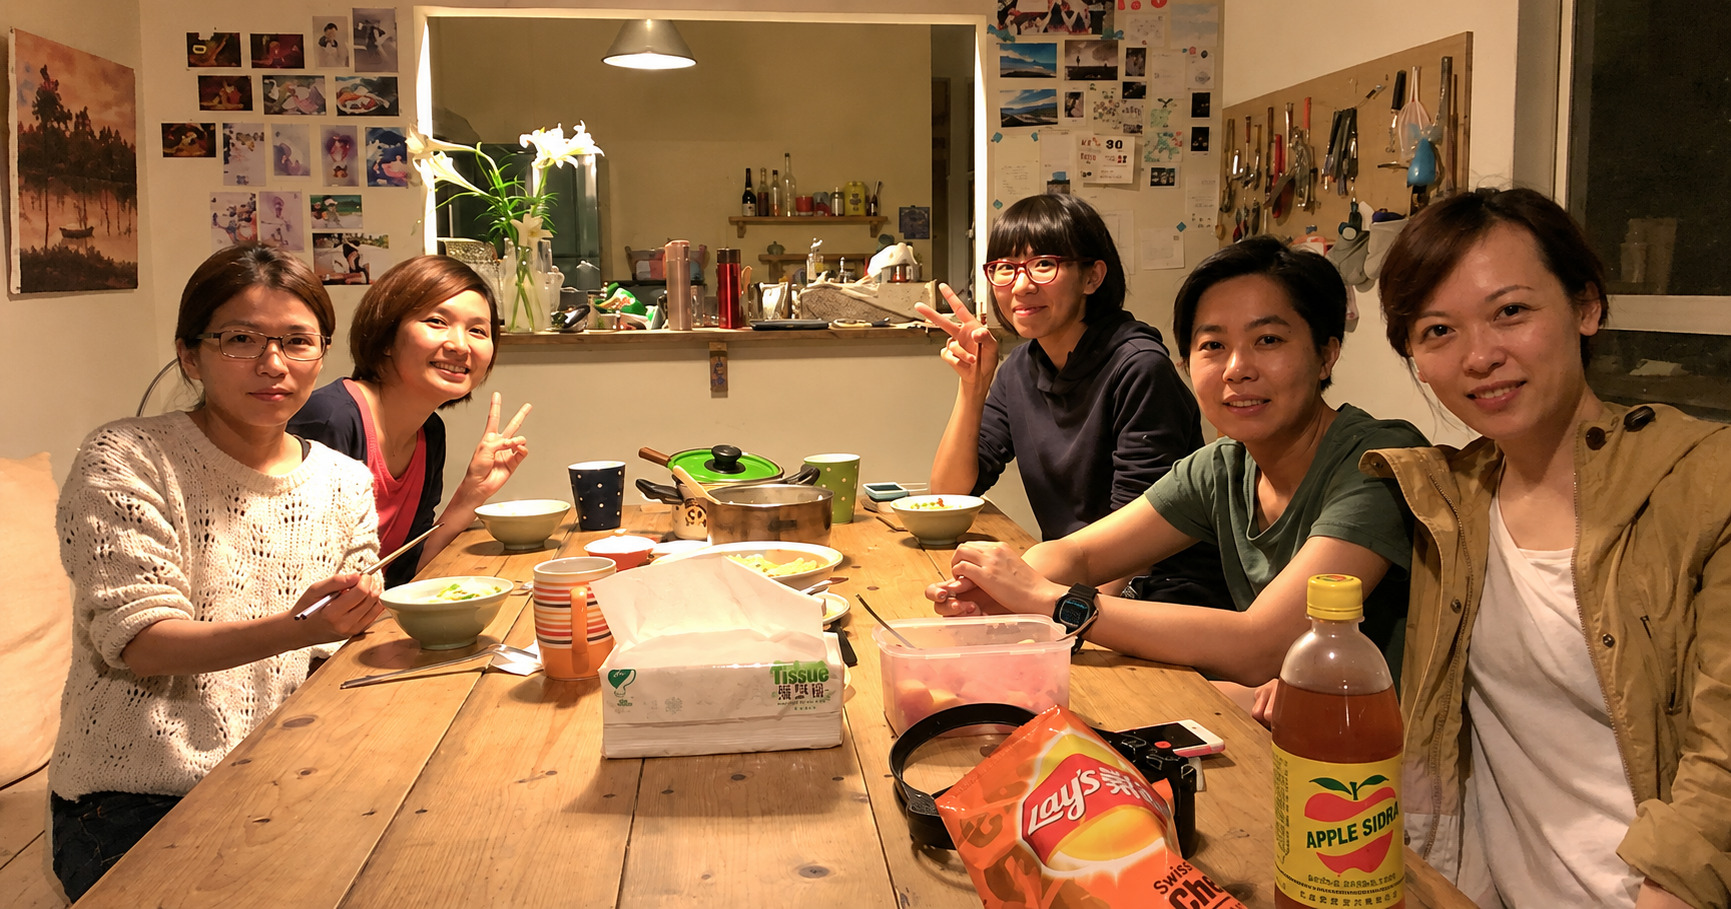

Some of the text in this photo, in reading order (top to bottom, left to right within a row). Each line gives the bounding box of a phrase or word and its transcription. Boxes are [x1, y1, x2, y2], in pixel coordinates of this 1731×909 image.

[1106, 139, 1123, 149] 30
[771, 662, 829, 685] Tissue
[1027, 768, 1101, 836] Lay's
[1306, 801, 1399, 849] APPLE SIDRA
[1153, 861, 1193, 895] Swiss
